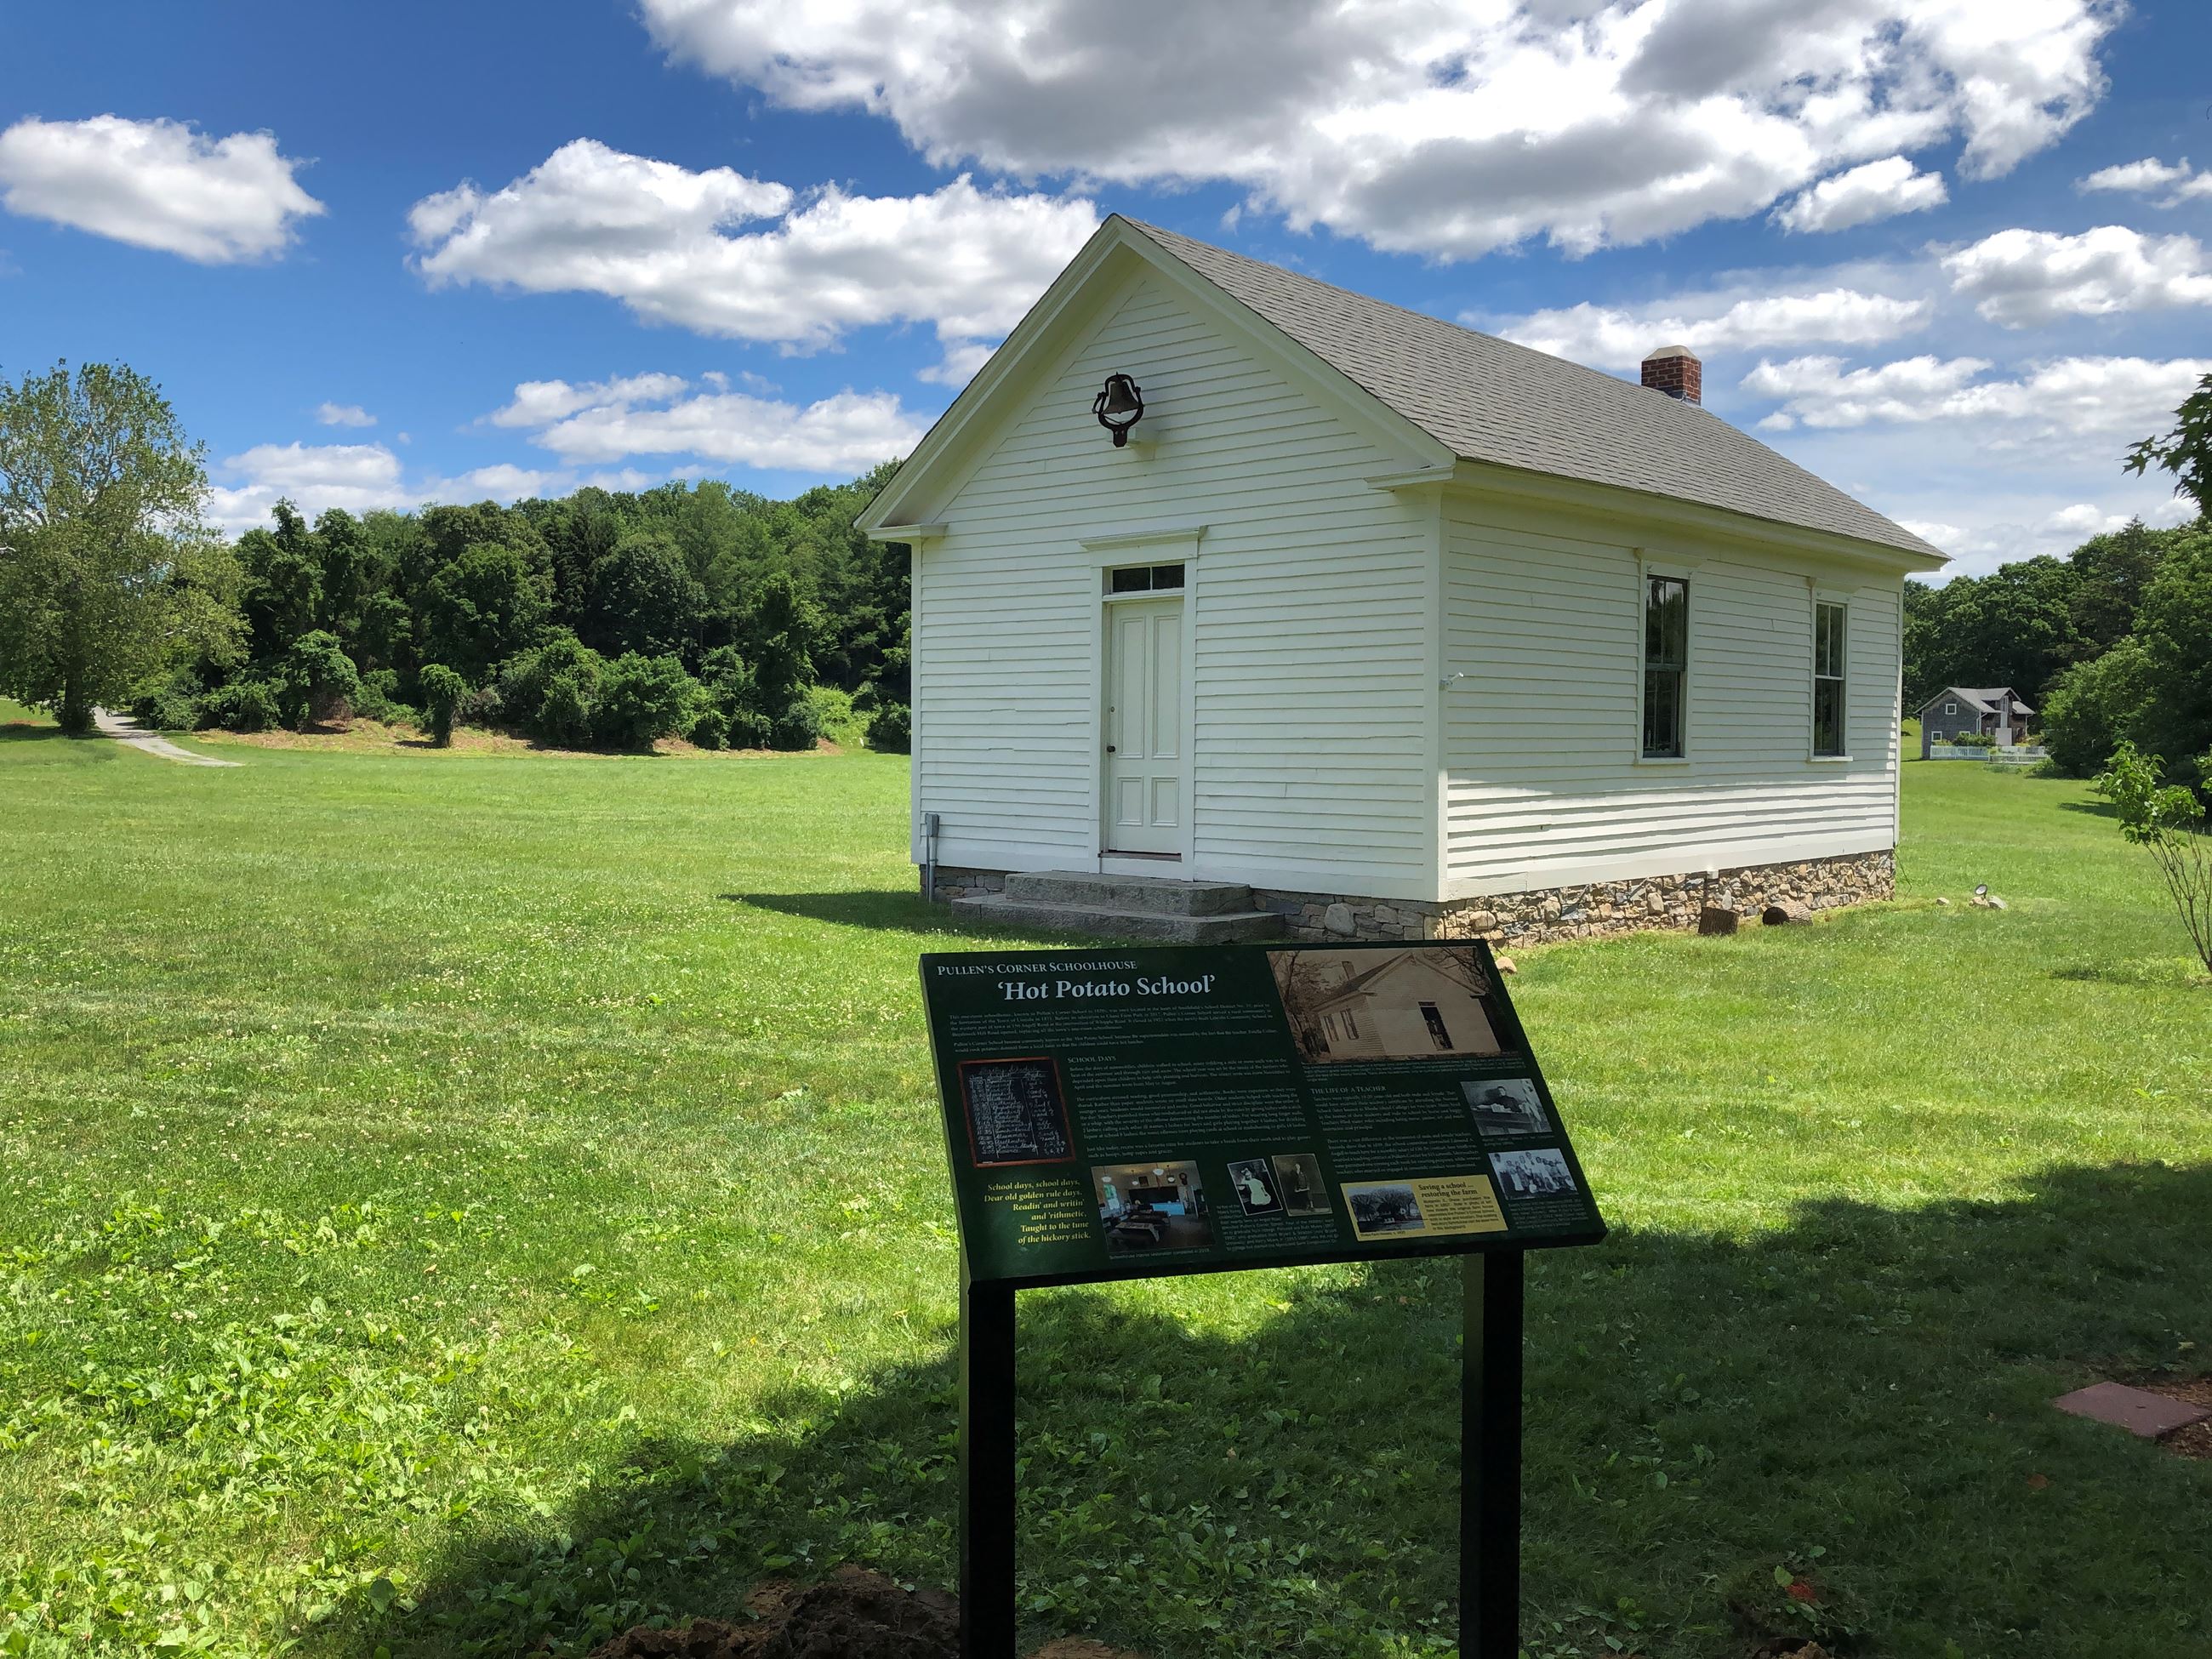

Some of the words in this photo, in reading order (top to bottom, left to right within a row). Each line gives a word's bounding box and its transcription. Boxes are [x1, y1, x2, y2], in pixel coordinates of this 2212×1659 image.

[938, 965, 995, 976] PULLEN'S
[996, 963, 1047, 974] CORNER
[1049, 961, 1137, 972] SCHOOLHOUSE
[997, 981, 1049, 1000] 'Hot
[1056, 980, 1131, 999] Potato
[1137, 974, 1216, 995] School'
[988, 1181, 1012, 1191] School
[1014, 1181, 1035, 1190] days,
[1035, 1178, 1059, 1188] school
[1445, 1181, 1467, 1189] school
[1018, 1191, 1044, 1202] golden
[1046, 1189, 1062, 1198] rule
[1012, 1201, 1042, 1211] Readin'
[1043, 1200, 1058, 1209] and
[1060, 1198, 1085, 1207] writin'
[1031, 1212, 1046, 1221] and
[1020, 1223, 1047, 1234] Taught
[1018, 1235, 1027, 1246] of
[1027, 1234, 1040, 1243] the
[1041, 1233, 1070, 1243] hickory
[1071, 1231, 1092, 1240] stick.
